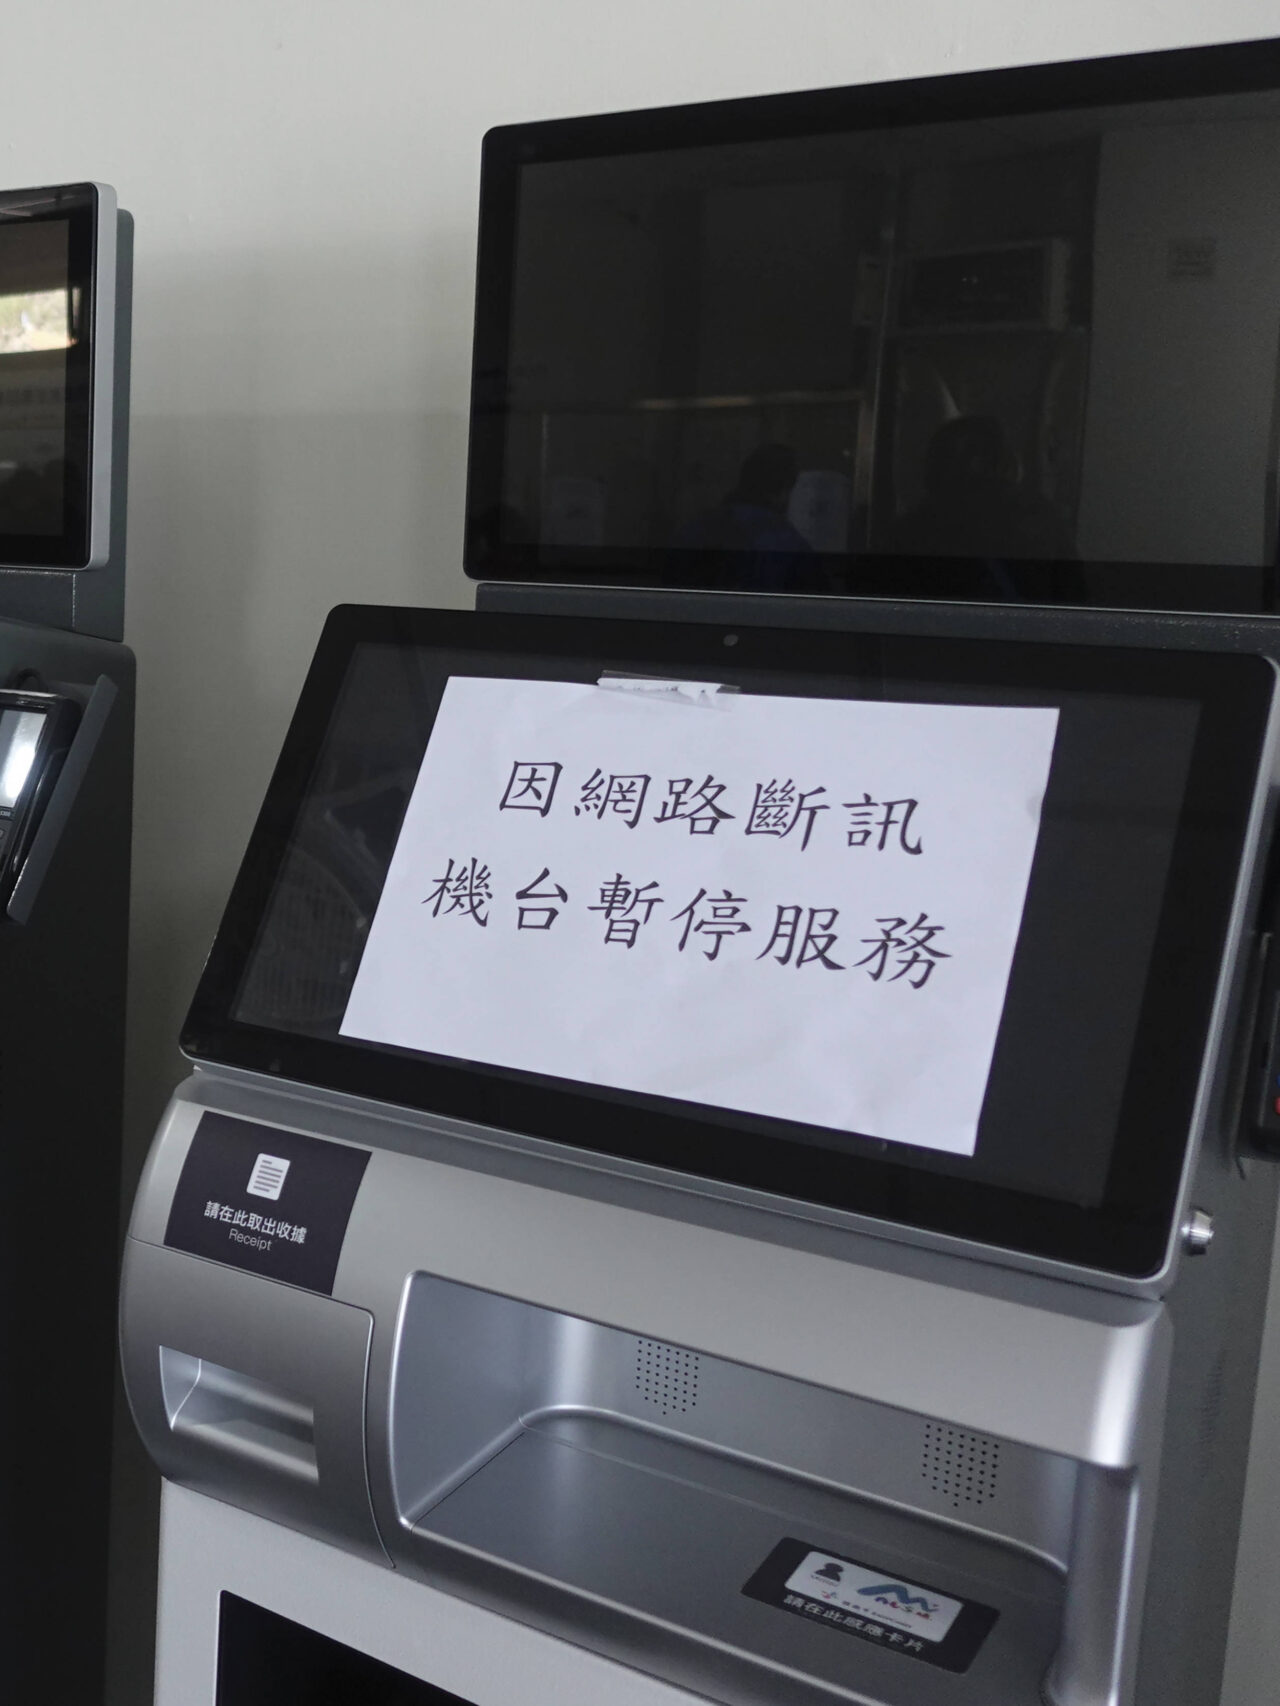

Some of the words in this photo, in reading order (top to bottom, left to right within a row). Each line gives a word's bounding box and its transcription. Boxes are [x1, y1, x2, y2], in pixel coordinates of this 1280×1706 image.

[499, 760, 925, 856] 因網路斷訊
[421, 857, 952, 990] 機台暫停服務
[204, 1200, 307, 1244] 請在此取出收據
[228, 1228, 272, 1252] Receipt
[783, 1594, 924, 1652] 請在此感應卡片
